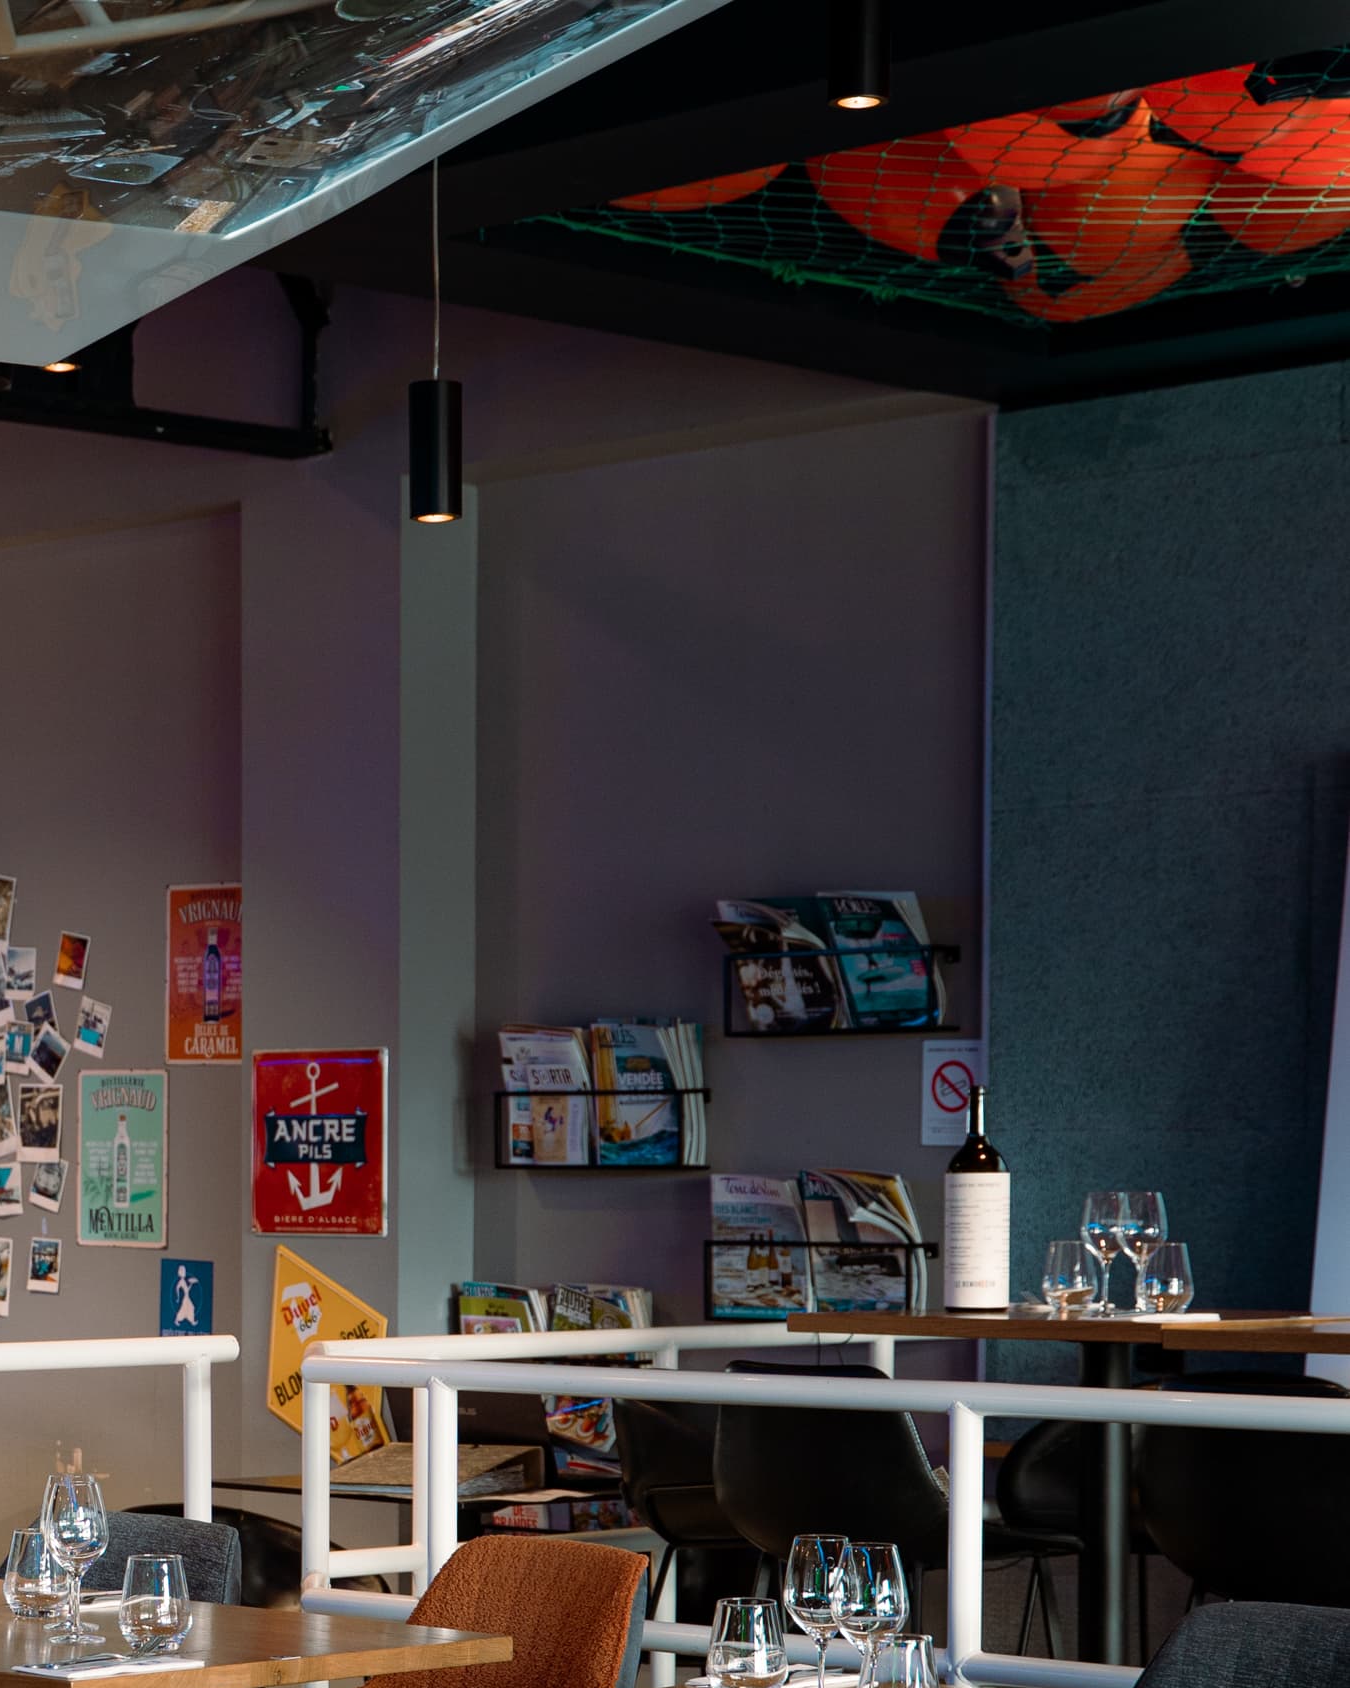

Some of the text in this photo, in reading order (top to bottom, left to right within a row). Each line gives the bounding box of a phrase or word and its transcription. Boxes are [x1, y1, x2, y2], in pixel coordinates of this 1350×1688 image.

[184, 1036, 239, 1059] CARAMEL
[91, 1086, 157, 1112] VRIGNAUD
[273, 1118, 357, 1142] ANCRE
[297, 1143, 333, 1160] PILS
[281, 1285, 323, 1327] Duvel
[299, 1310, 318, 1333] 666
